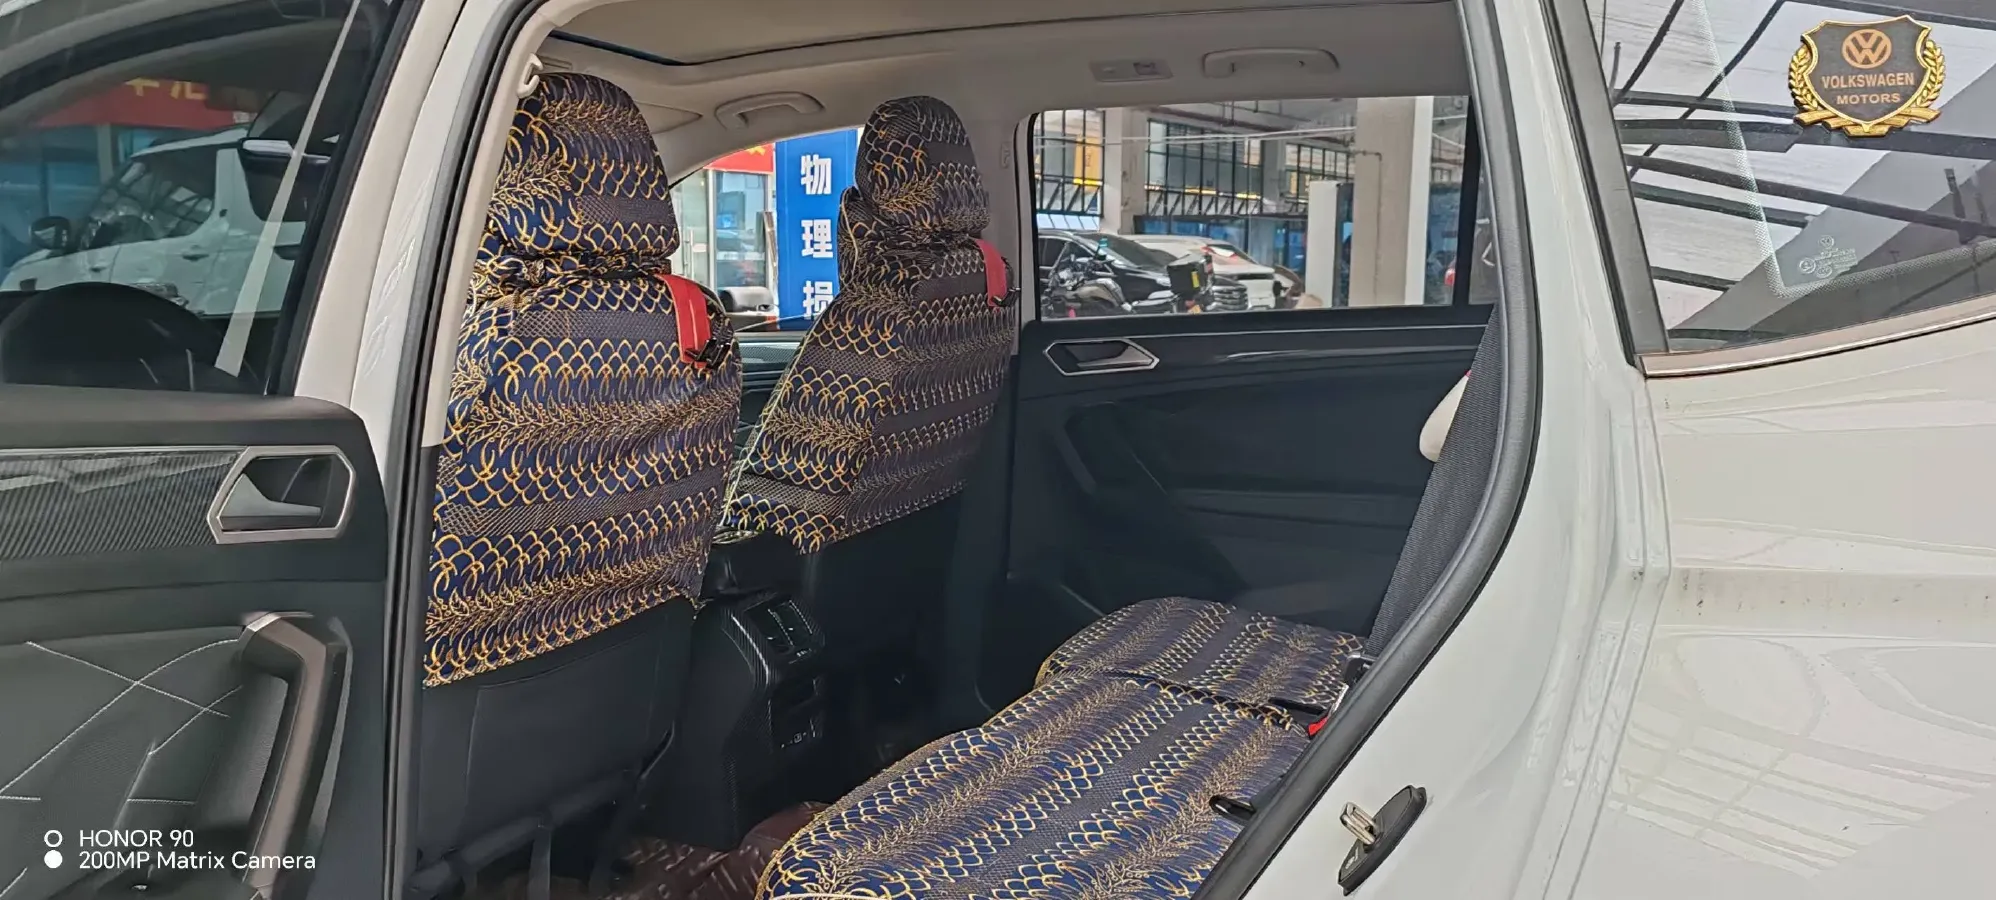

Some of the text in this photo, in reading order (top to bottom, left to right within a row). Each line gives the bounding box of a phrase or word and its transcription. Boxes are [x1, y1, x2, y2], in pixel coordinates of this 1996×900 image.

[1821, 72, 1915, 89] VOLKSWAGEN
[1836, 93, 1901, 105] MOTORS
[800, 154, 834, 320] 物理损
